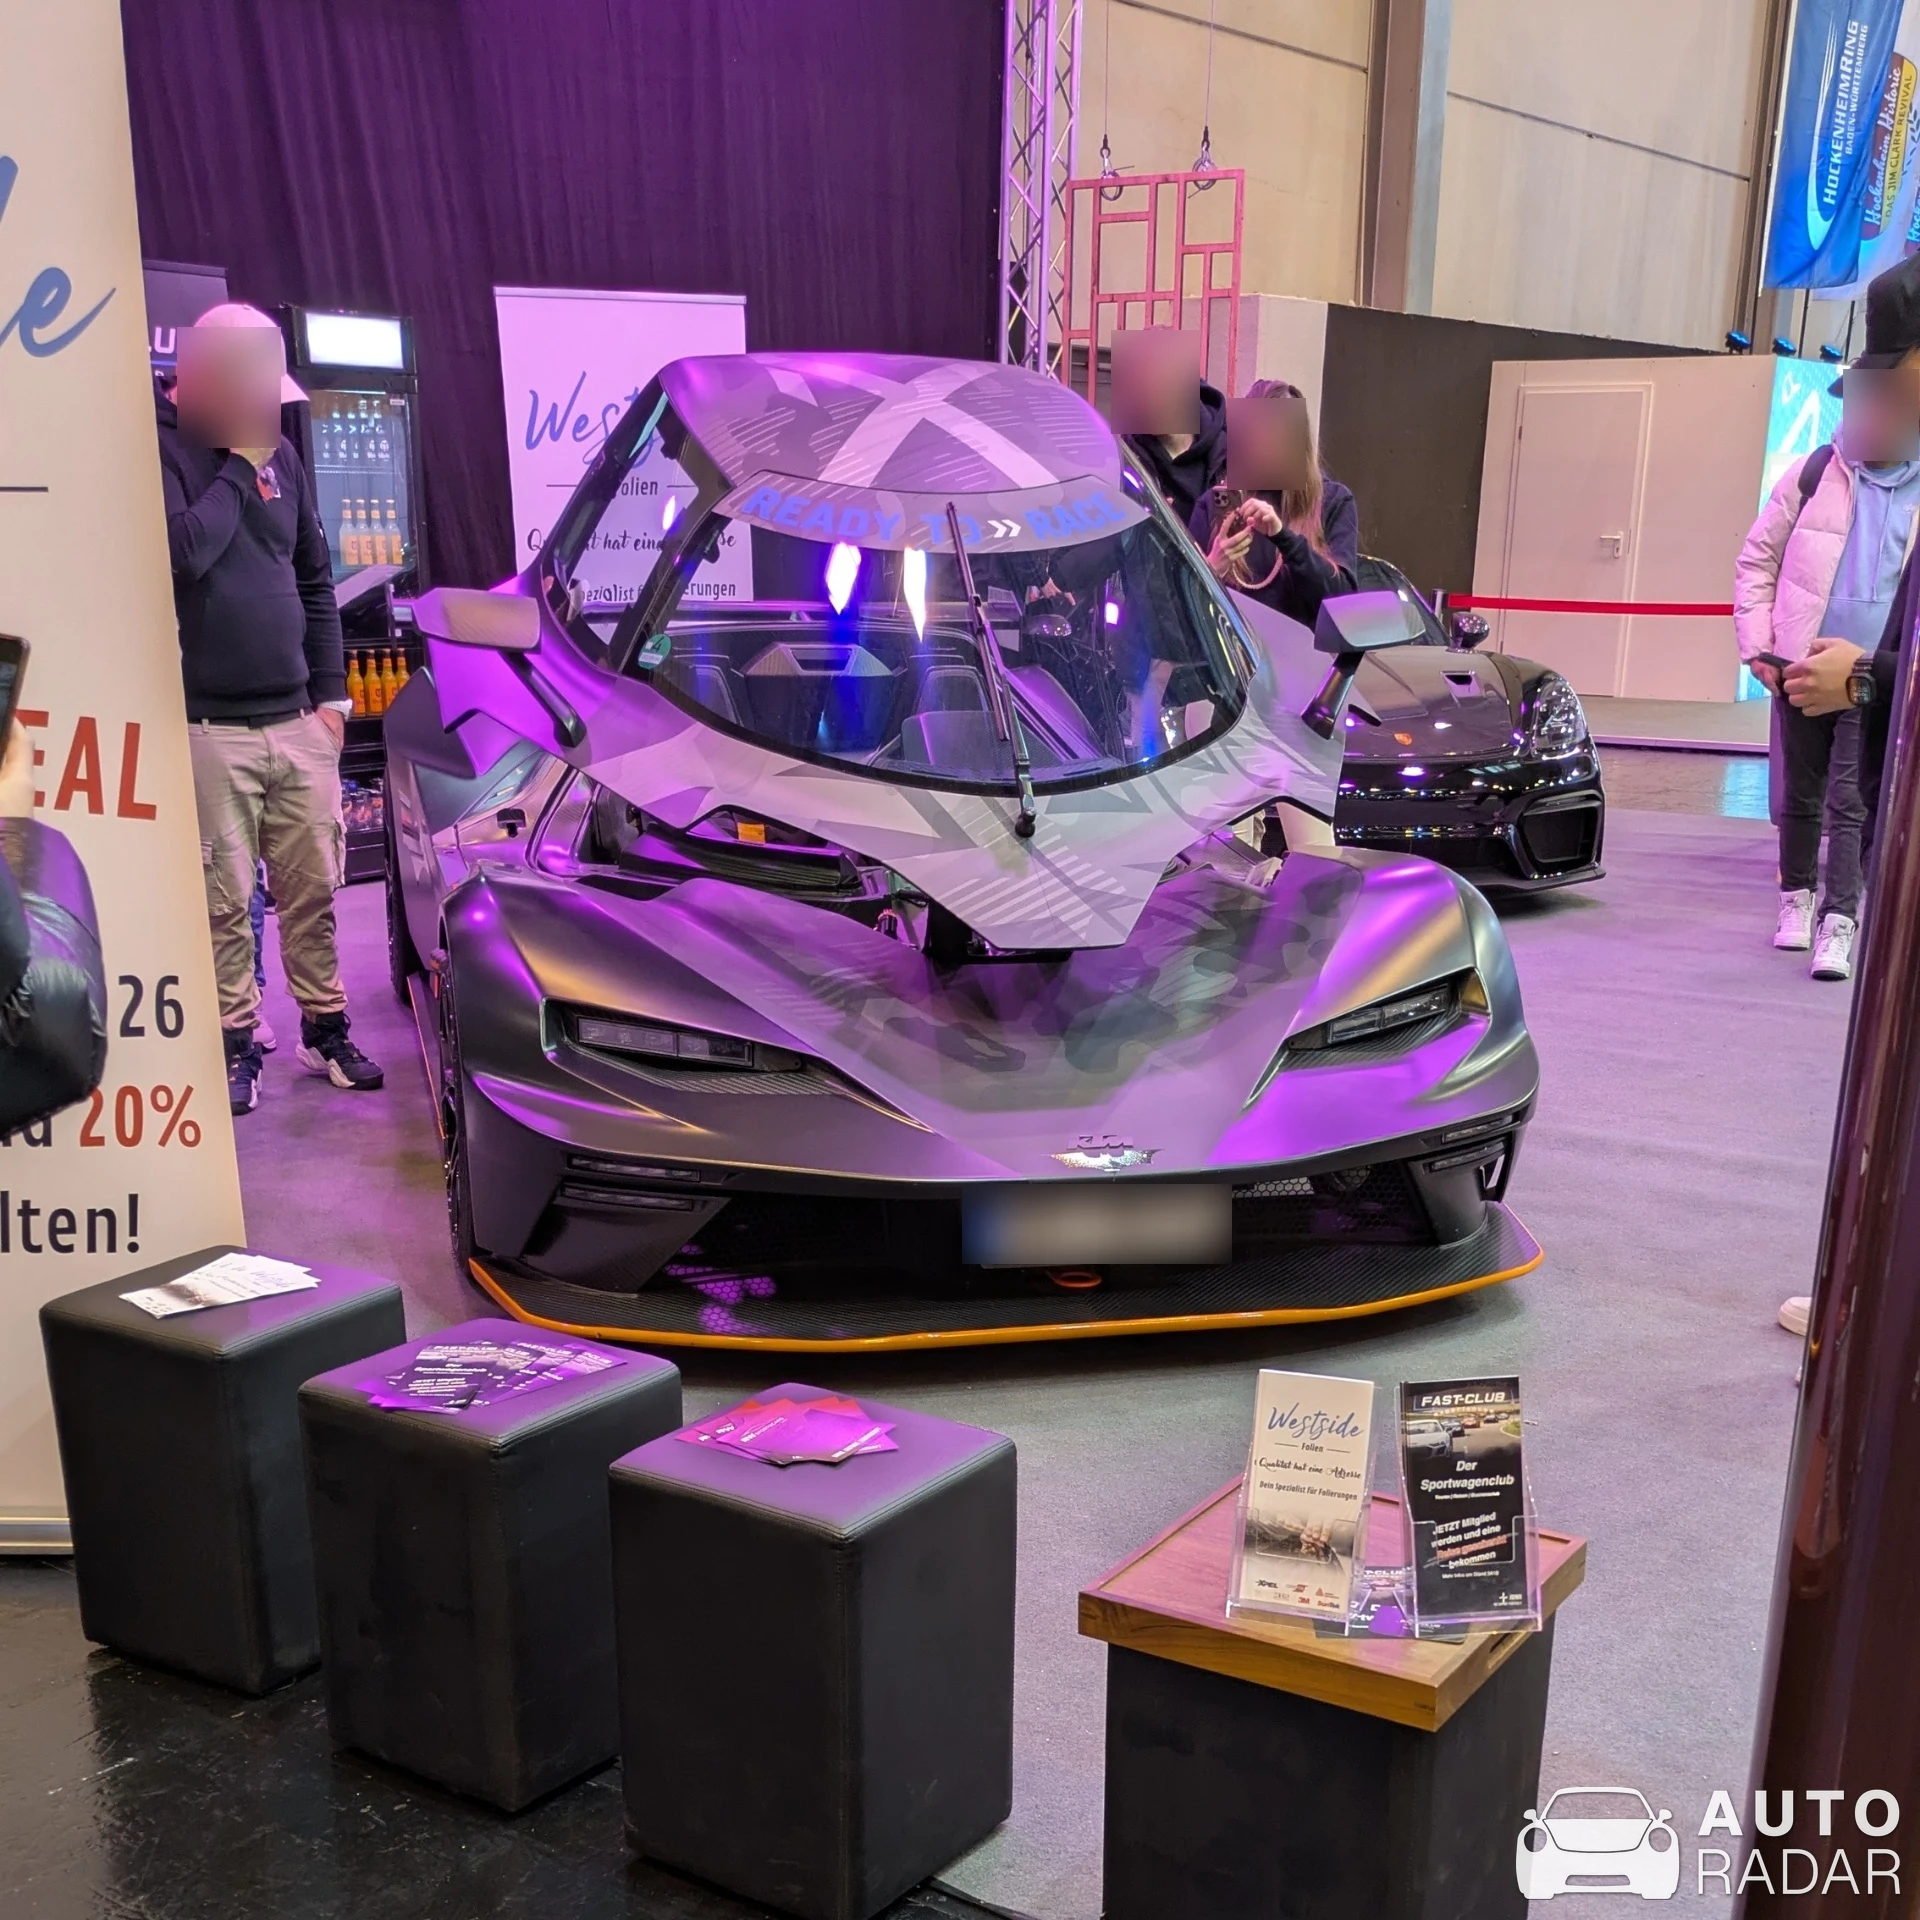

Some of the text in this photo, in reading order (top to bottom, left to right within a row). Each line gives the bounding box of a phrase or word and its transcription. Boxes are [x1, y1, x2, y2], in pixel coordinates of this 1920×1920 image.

[1822, 20, 1859, 206] HOCKENHEIMRING
[1863, 67, 1902, 226] Hockenheim Historic
[1885, 75, 1913, 218] DAS JIM CLARK REVIVAL
[621, 477, 659, 496] olien
[741, 486, 901, 541] READY
[1025, 491, 1126, 541] RACE
[603, 530, 630, 550] hat
[80, 1084, 202, 1147] 20%
[0, 1190, 140, 1254] lten!
[1421, 1392, 1506, 1407] FAST-CLUB
[1267, 1401, 1365, 1441] Westside
[1301, 1442, 1324, 1453] Folien
[1293, 1462, 1308, 1473] hat
[1308, 1465, 1323, 1474] eine
[1325, 1466, 1362, 1480] Adresse
[1456, 1460, 1478, 1472] Der
[1259, 1480, 1358, 1502] Dein Spezialist für Folierungen
[1420, 1474, 1515, 1493] Sportwagenclub
[1432, 1511, 1497, 1536] JETZT Mitglied
[1431, 1524, 1502, 1549] werden und eine
[1448, 1551, 1497, 1570] bekommen
